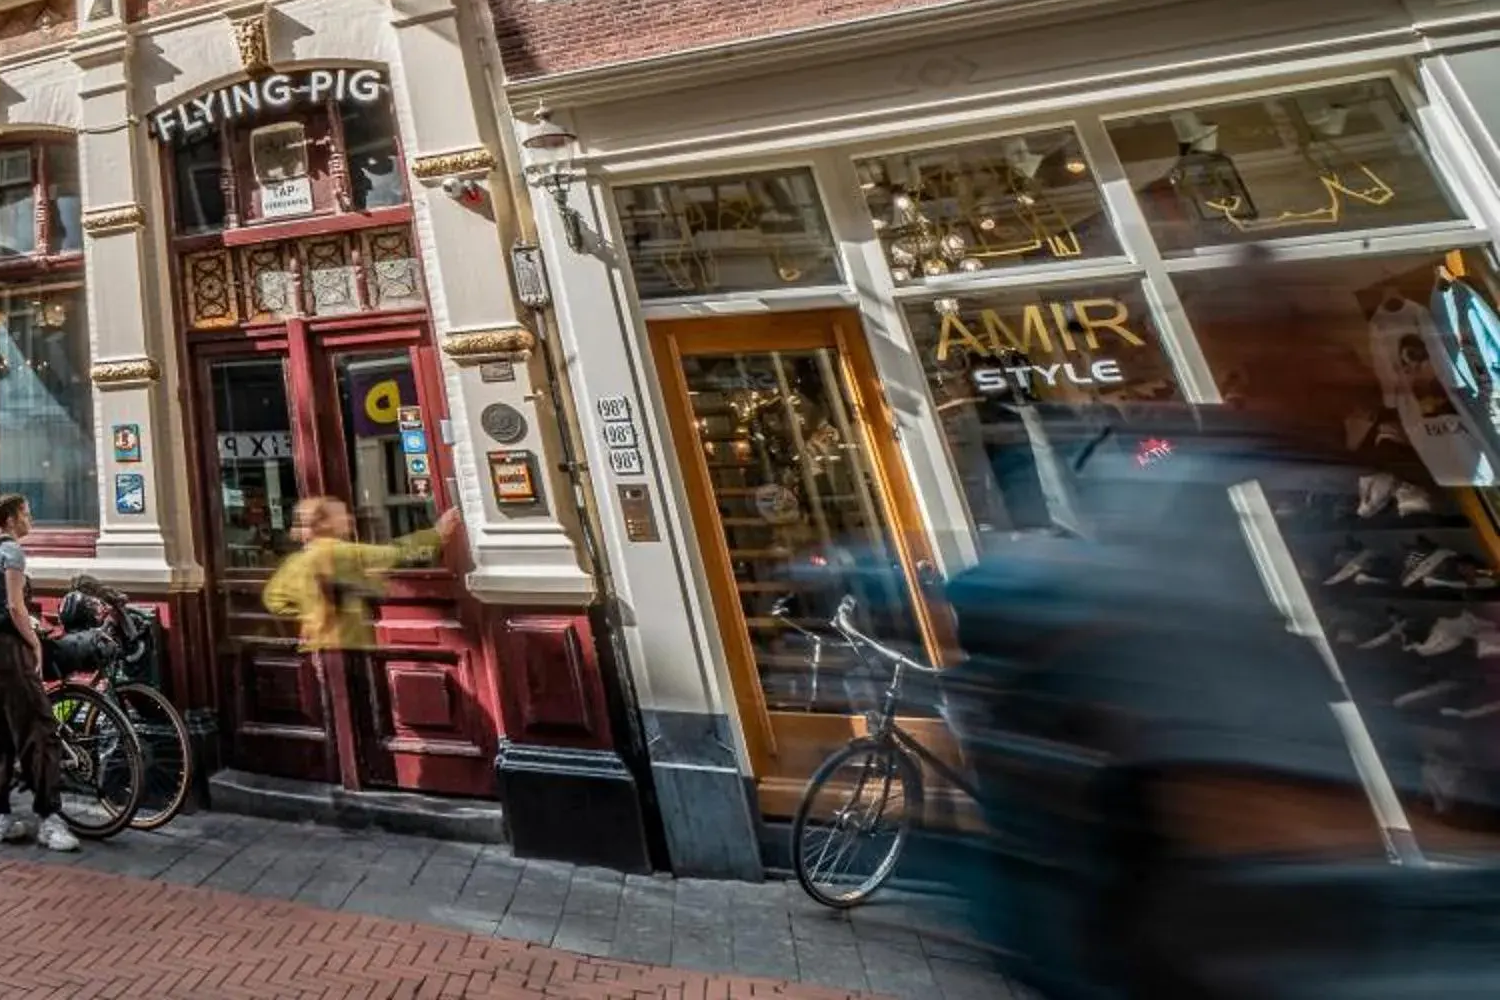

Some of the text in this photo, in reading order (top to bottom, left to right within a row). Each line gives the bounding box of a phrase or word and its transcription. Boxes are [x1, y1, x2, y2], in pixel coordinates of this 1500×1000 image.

[155, 69, 381, 142] FLYING PIG
[937, 298, 1146, 361] AMIR
[973, 359, 1124, 394] STYLE
